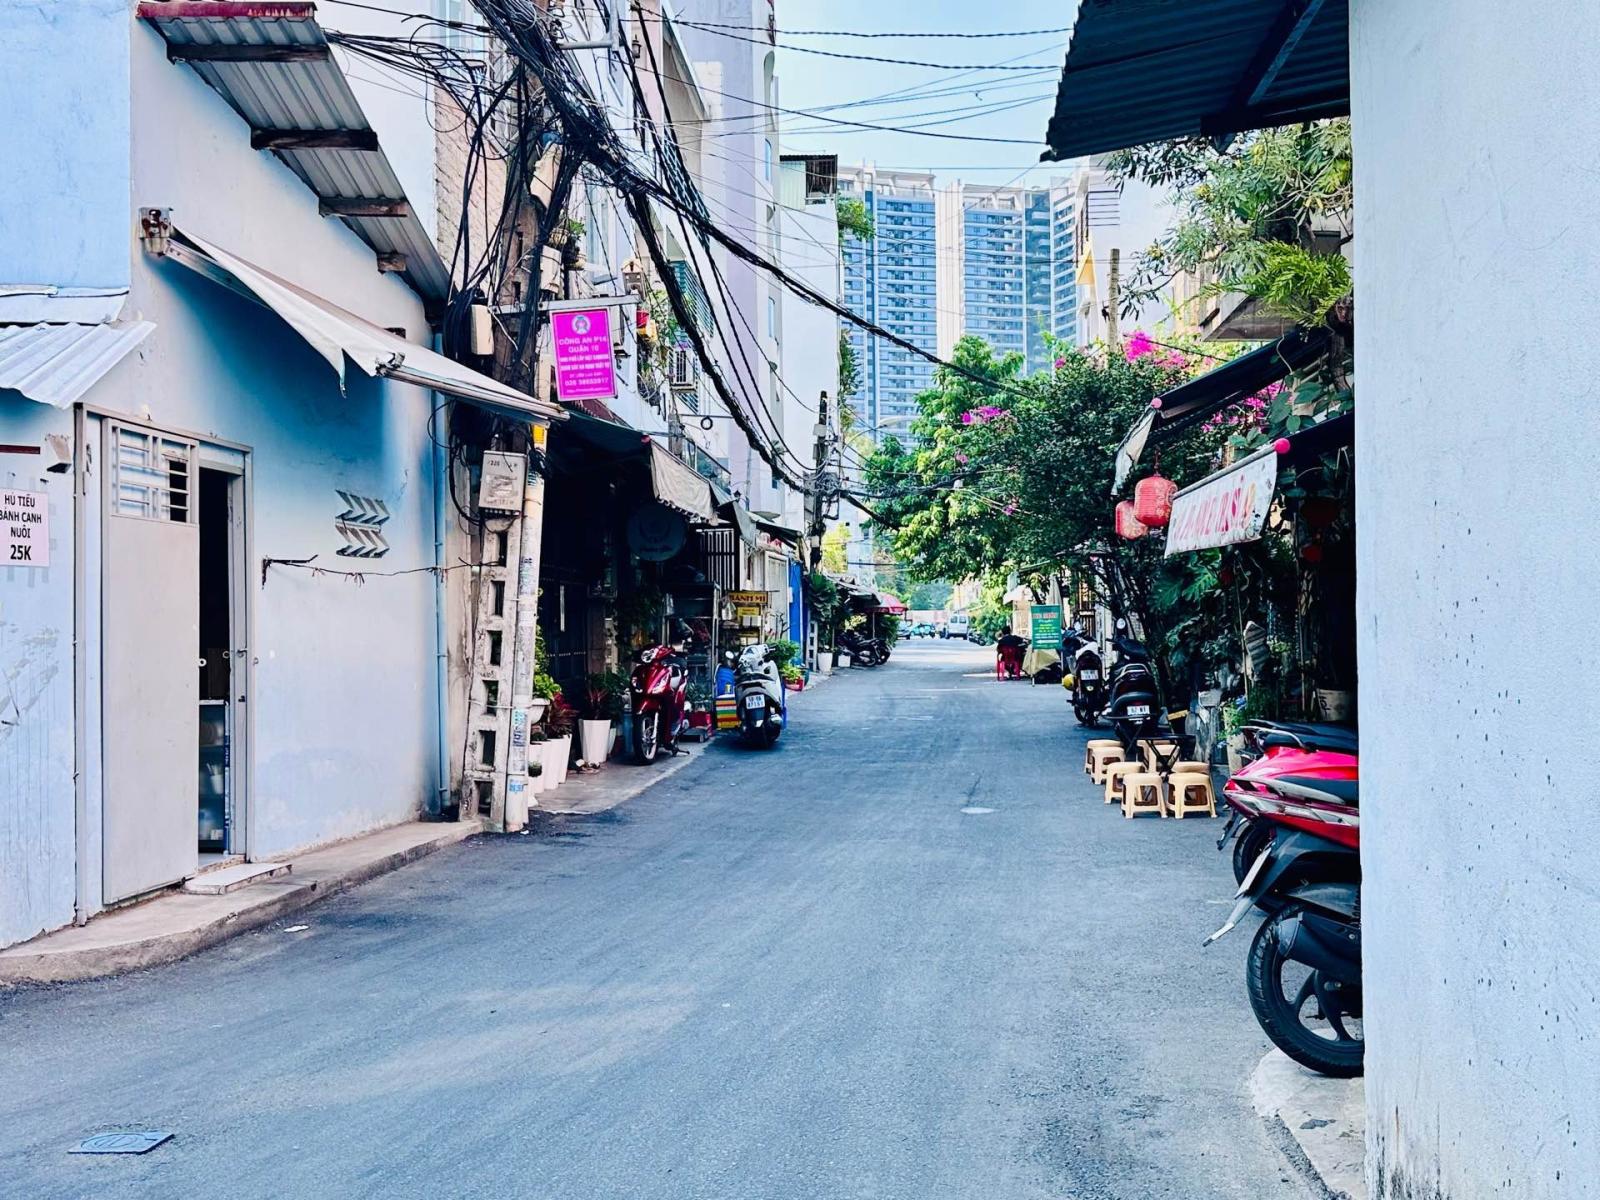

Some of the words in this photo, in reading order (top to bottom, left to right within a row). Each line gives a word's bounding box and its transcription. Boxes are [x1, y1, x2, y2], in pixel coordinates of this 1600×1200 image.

[21, 512, 42, 524] CANH
[10, 524, 31, 539] NUÔI
[10, 544, 32, 561] 25K
